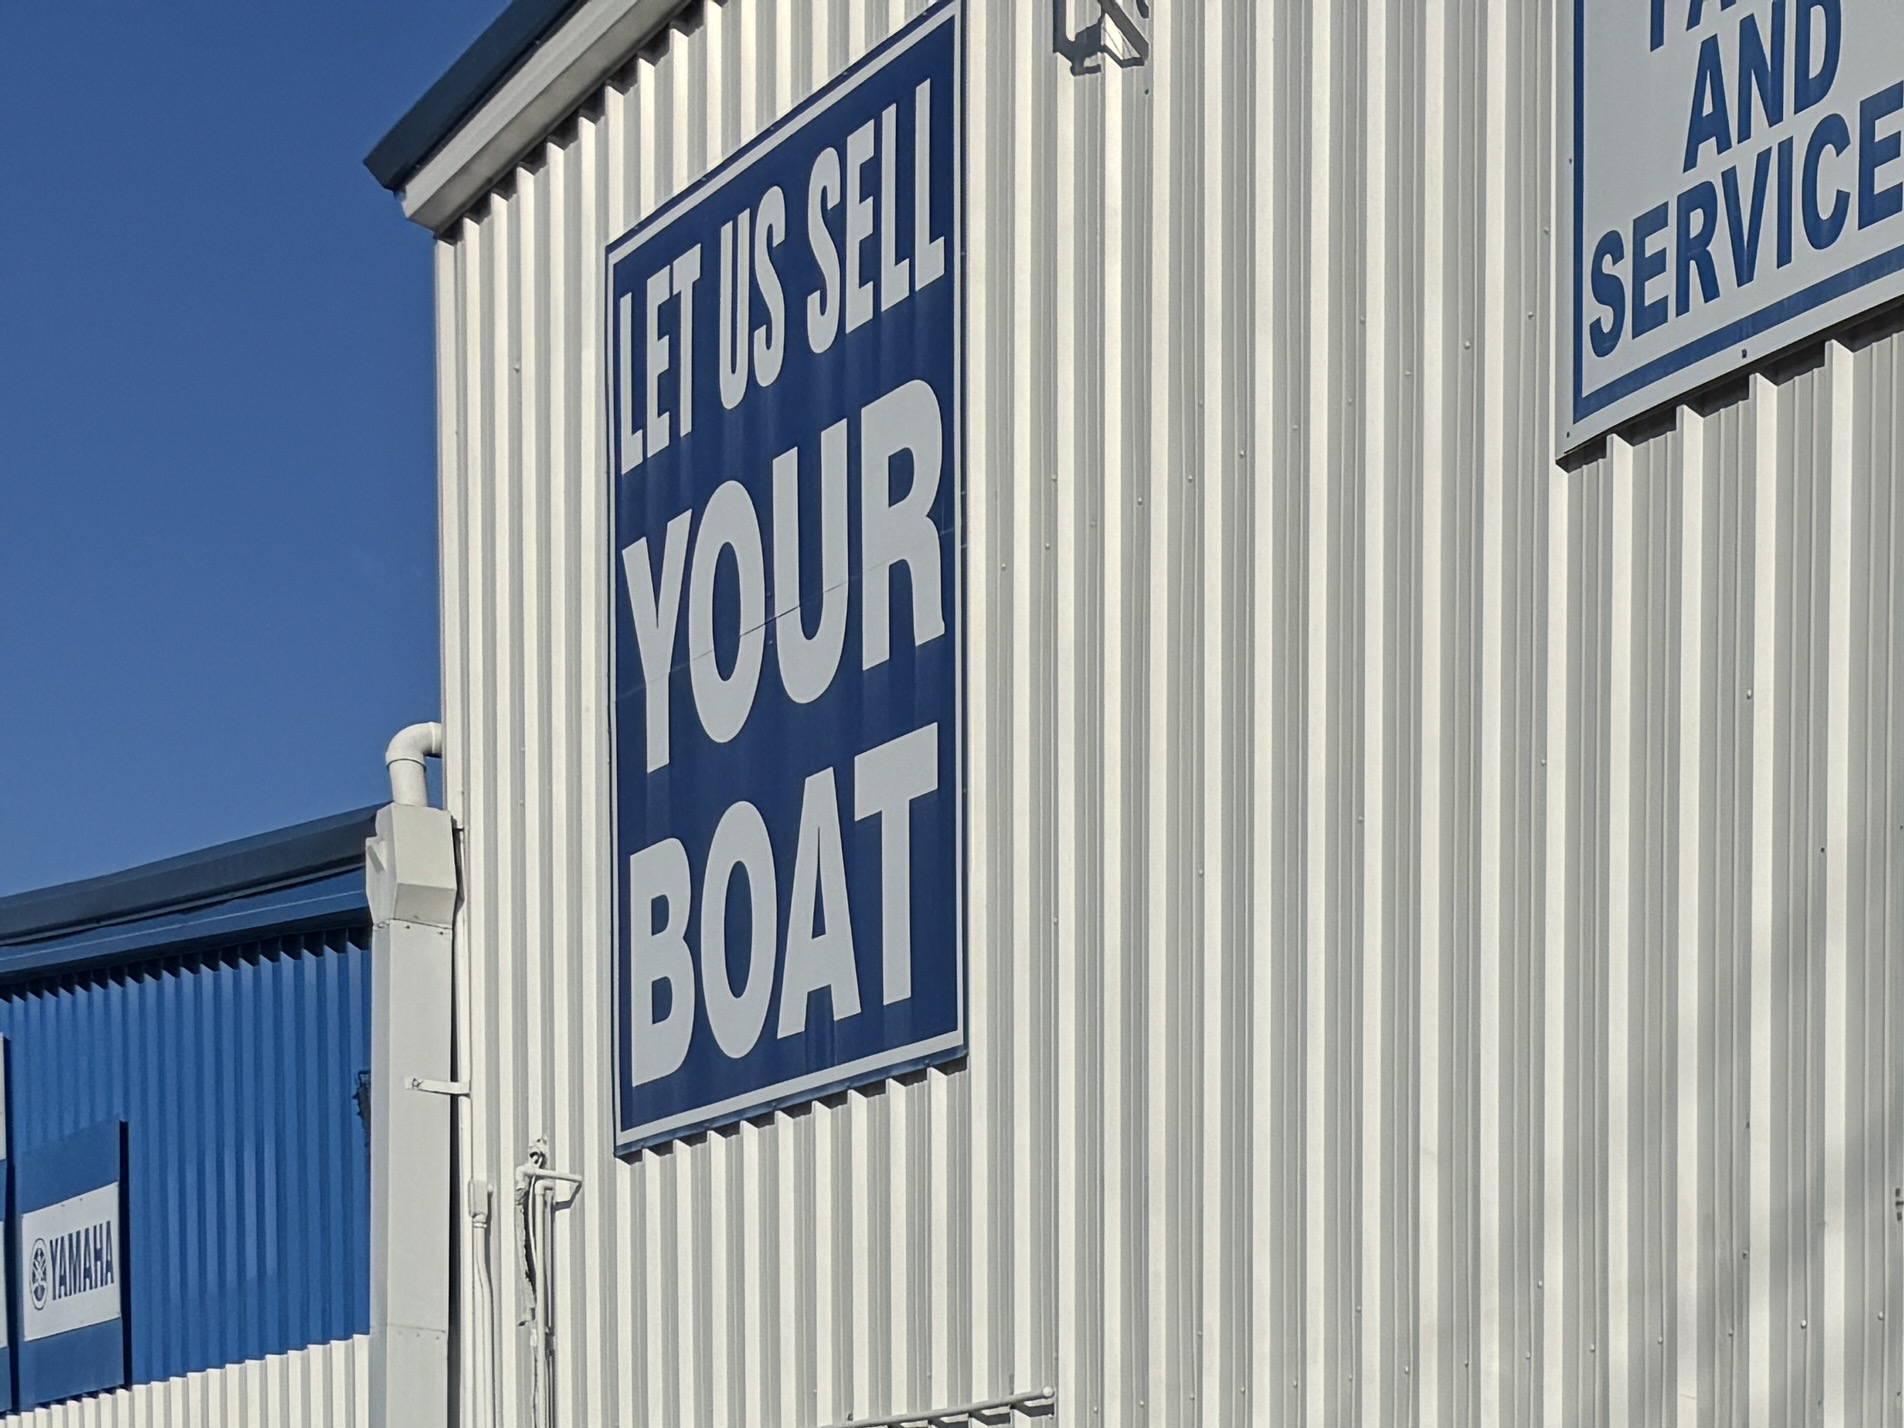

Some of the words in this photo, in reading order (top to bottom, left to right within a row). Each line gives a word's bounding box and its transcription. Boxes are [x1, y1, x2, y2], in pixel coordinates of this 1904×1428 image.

[1683, 0, 1841, 174] AND
[618, 244, 701, 475] LET
[718, 185, 785, 410] US
[807, 79, 946, 354] SELL
[621, 379, 945, 773] YOUR
[629, 721, 939, 1087] BOAT
[49, 1220, 115, 1301] YAMAHA
